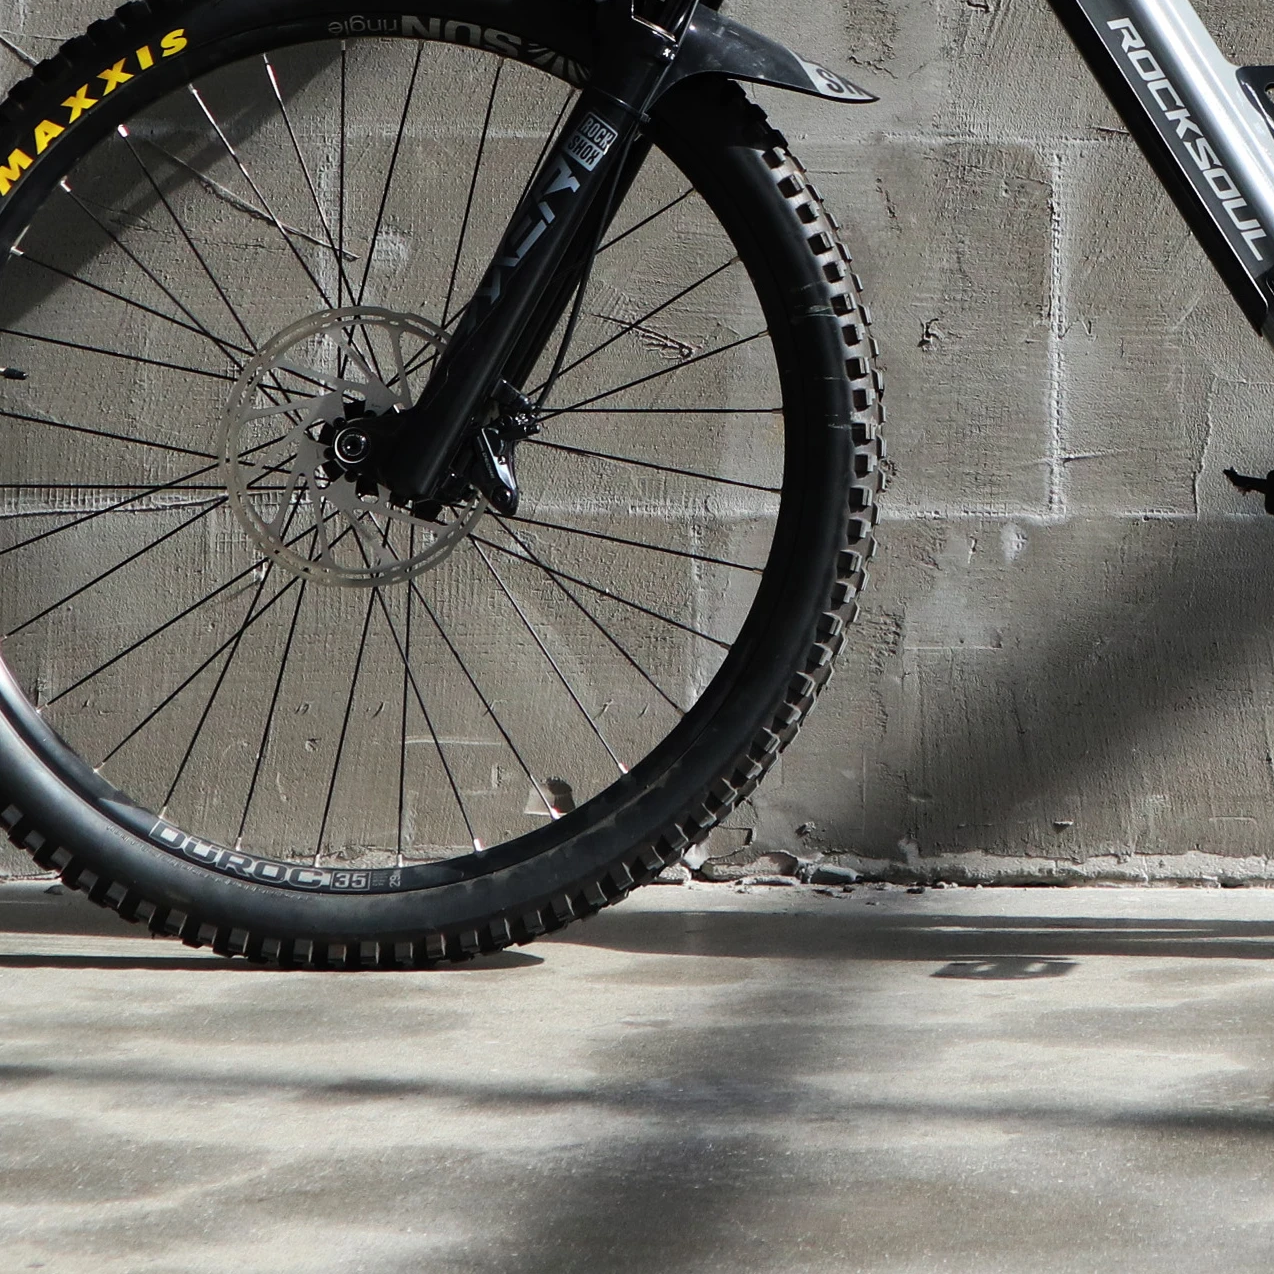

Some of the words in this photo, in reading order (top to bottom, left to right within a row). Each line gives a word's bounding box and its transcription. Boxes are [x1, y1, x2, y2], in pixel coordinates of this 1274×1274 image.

[401, 15, 522, 57] SUN
[0, 28, 188, 197] MAXXIS
[567, 135, 600, 166] SHOX
[580, 117, 614, 149] ROCK
[1106, 17, 1267, 262] ROCKSOUL
[333, 872, 368, 889] 35
